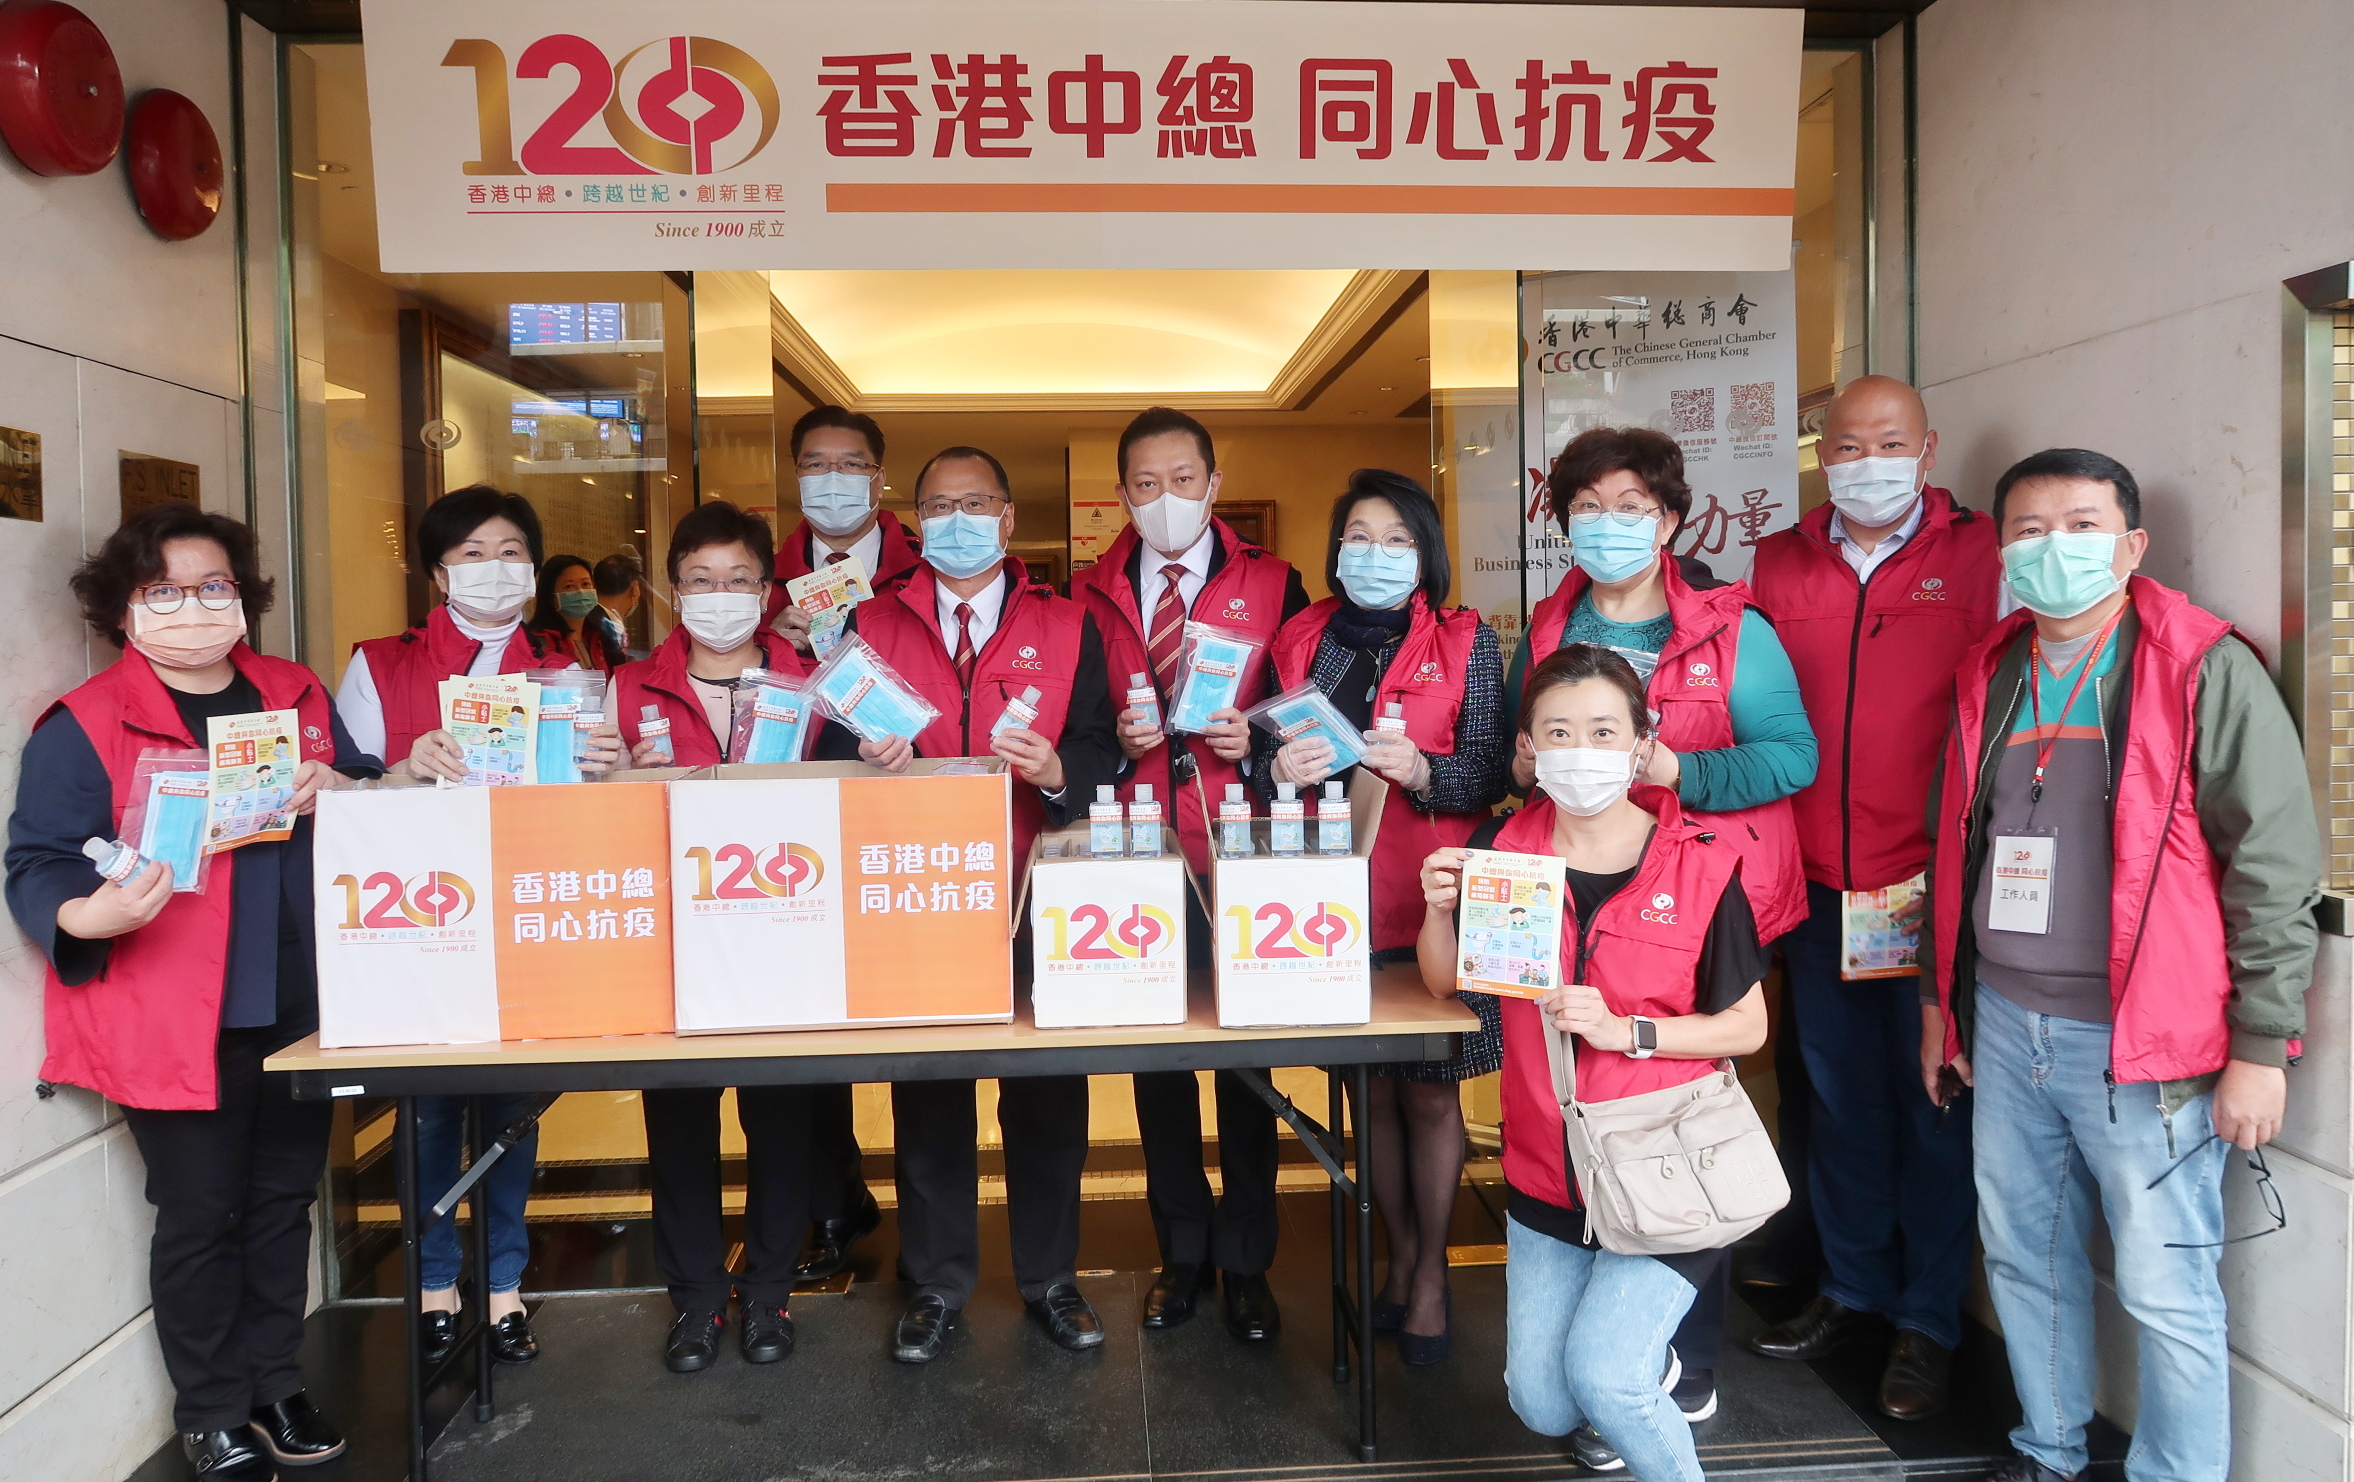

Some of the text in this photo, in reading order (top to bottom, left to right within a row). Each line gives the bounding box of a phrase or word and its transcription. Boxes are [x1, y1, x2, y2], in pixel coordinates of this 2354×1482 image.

[441, 34, 781, 175] 120
[817, 52, 1718, 163] 香港中總 同心抗疫
[654, 220, 785, 239] Since 1900 成立
[1612, 330, 1777, 356] The Chinese General Chamber
[1537, 347, 1606, 374] CGCC
[1612, 345, 1749, 368] of Commerce, Hong Kong
[1733, 443, 1760, 451] Wechat
[1733, 451, 1773, 460] CGCCINFO
[1912, 591, 1946, 601] CGCC
[1222, 609, 1250, 621] CGCC
[1012, 659, 1042, 670] CGCC
[1413, 672, 1443, 682] CGCC
[1687, 676, 1718, 688] CGCC
[858, 841, 996, 876] 香港中總
[684, 842, 824, 901] 120
[511, 867, 655, 905] 香港中總
[2000, 888, 2039, 901] 工作人員
[331, 871, 475, 929] 120
[860, 880, 997, 915] 同心抗疫
[513, 907, 656, 944] 同心抗疫
[771, 913, 827, 923] Since 1900 成立
[1640, 909, 1678, 925] CGCC
[1040, 903, 1176, 960] 120
[1224, 902, 1362, 959] 120
[441, 945, 459, 953] 1900
[459, 944, 477, 952] 成立
[1122, 976, 1142, 984] Since
[1160, 975, 1176, 983] 成立
[1308, 974, 1363, 984] Since 1900 成立
